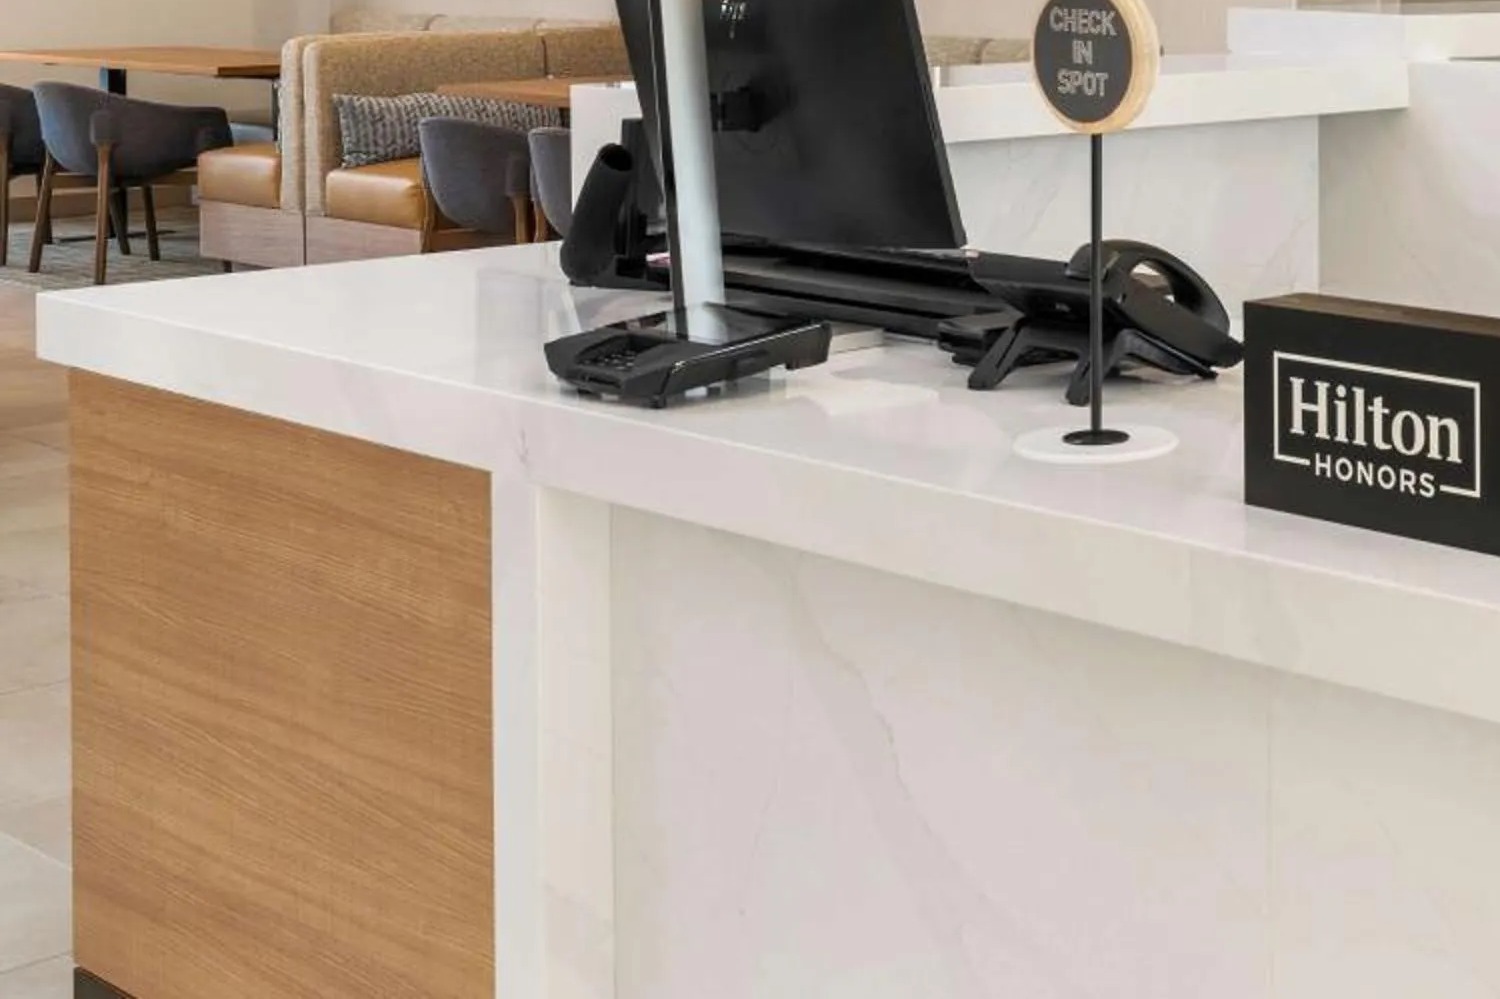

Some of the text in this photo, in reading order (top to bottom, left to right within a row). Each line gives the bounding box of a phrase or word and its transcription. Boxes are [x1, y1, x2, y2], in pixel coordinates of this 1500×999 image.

[1050, 6, 1117, 36] CHECK
[1072, 39, 1093, 65] IN
[1057, 69, 1109, 97] SPOT
[1289, 376, 1463, 464] Hilton
[1314, 452, 1436, 498] HONORS
